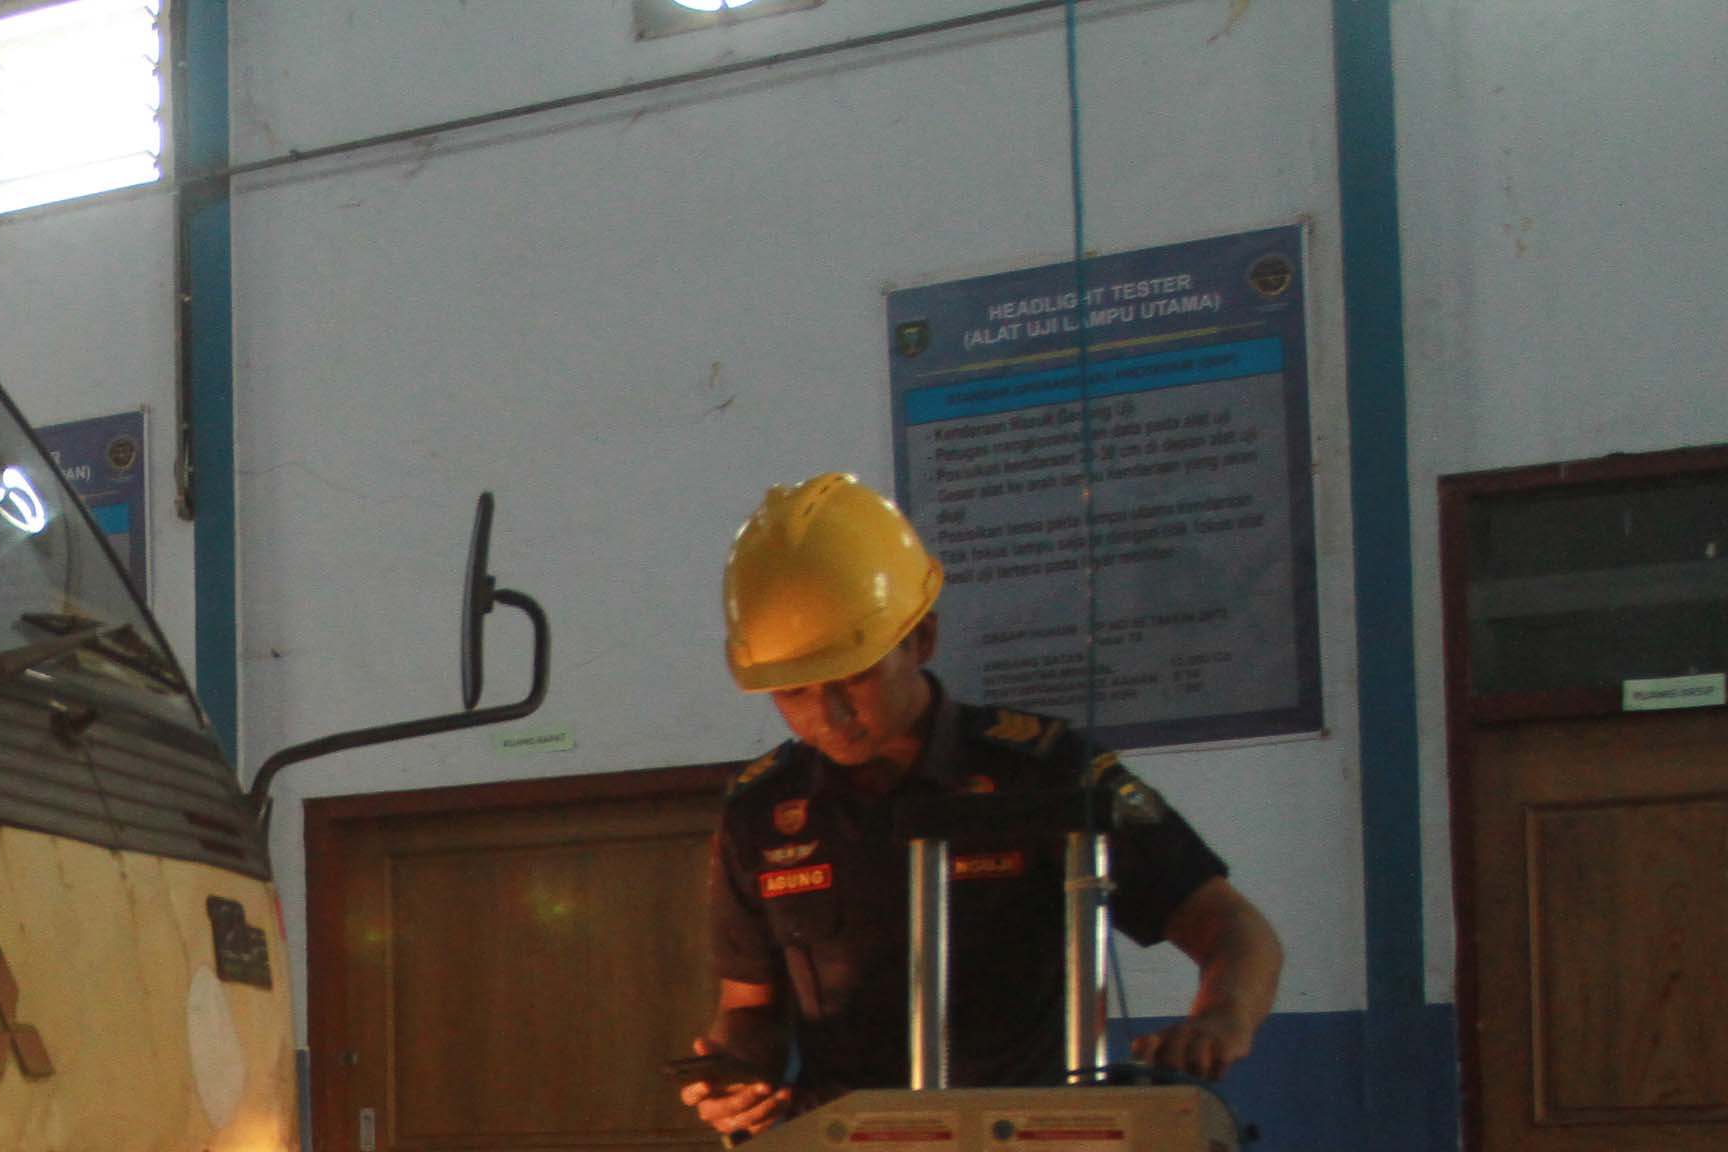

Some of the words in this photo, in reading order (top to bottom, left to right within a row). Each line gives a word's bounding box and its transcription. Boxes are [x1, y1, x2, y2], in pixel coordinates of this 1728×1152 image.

[963, 321, 1023, 350] (ALAT
[1026, 317, 1058, 338] UJI
[1139, 293, 1223, 319] UTAMA)
[987, 287, 1105, 321] HEADLIGHT
[1111, 273, 1193, 301] TESTER
